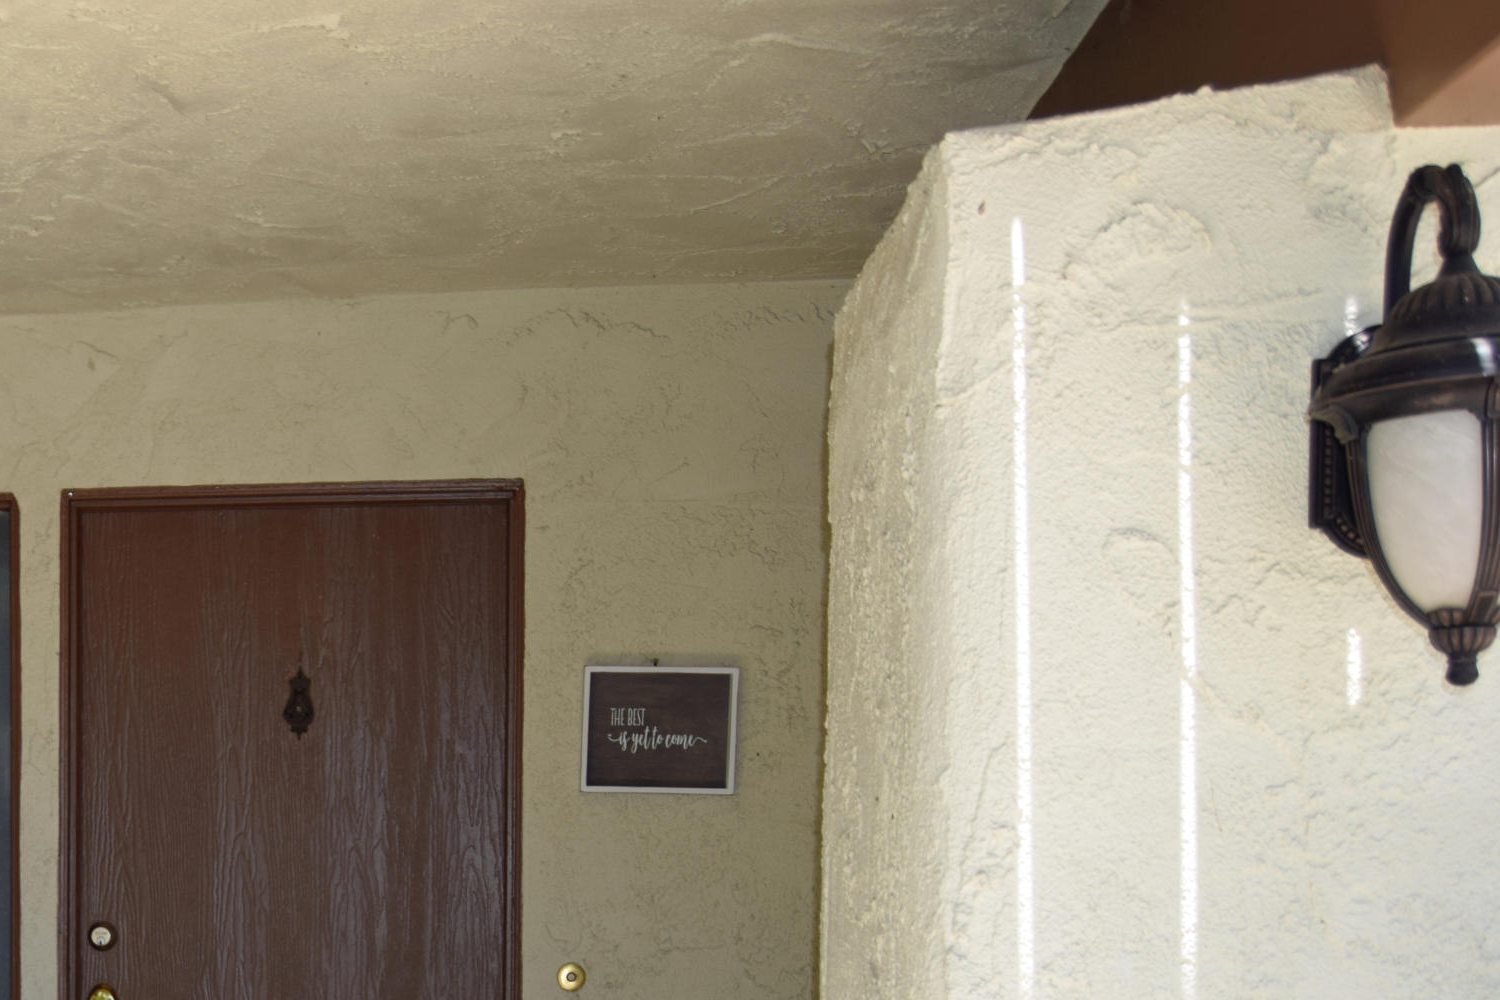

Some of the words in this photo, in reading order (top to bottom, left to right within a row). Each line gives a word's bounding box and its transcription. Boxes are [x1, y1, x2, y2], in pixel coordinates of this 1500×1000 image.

[610, 708, 625, 726] THE
[627, 708, 646, 726] BEST
[631, 725, 651, 754] yet
[651, 725, 664, 750] to
[665, 733, 707, 750] come
